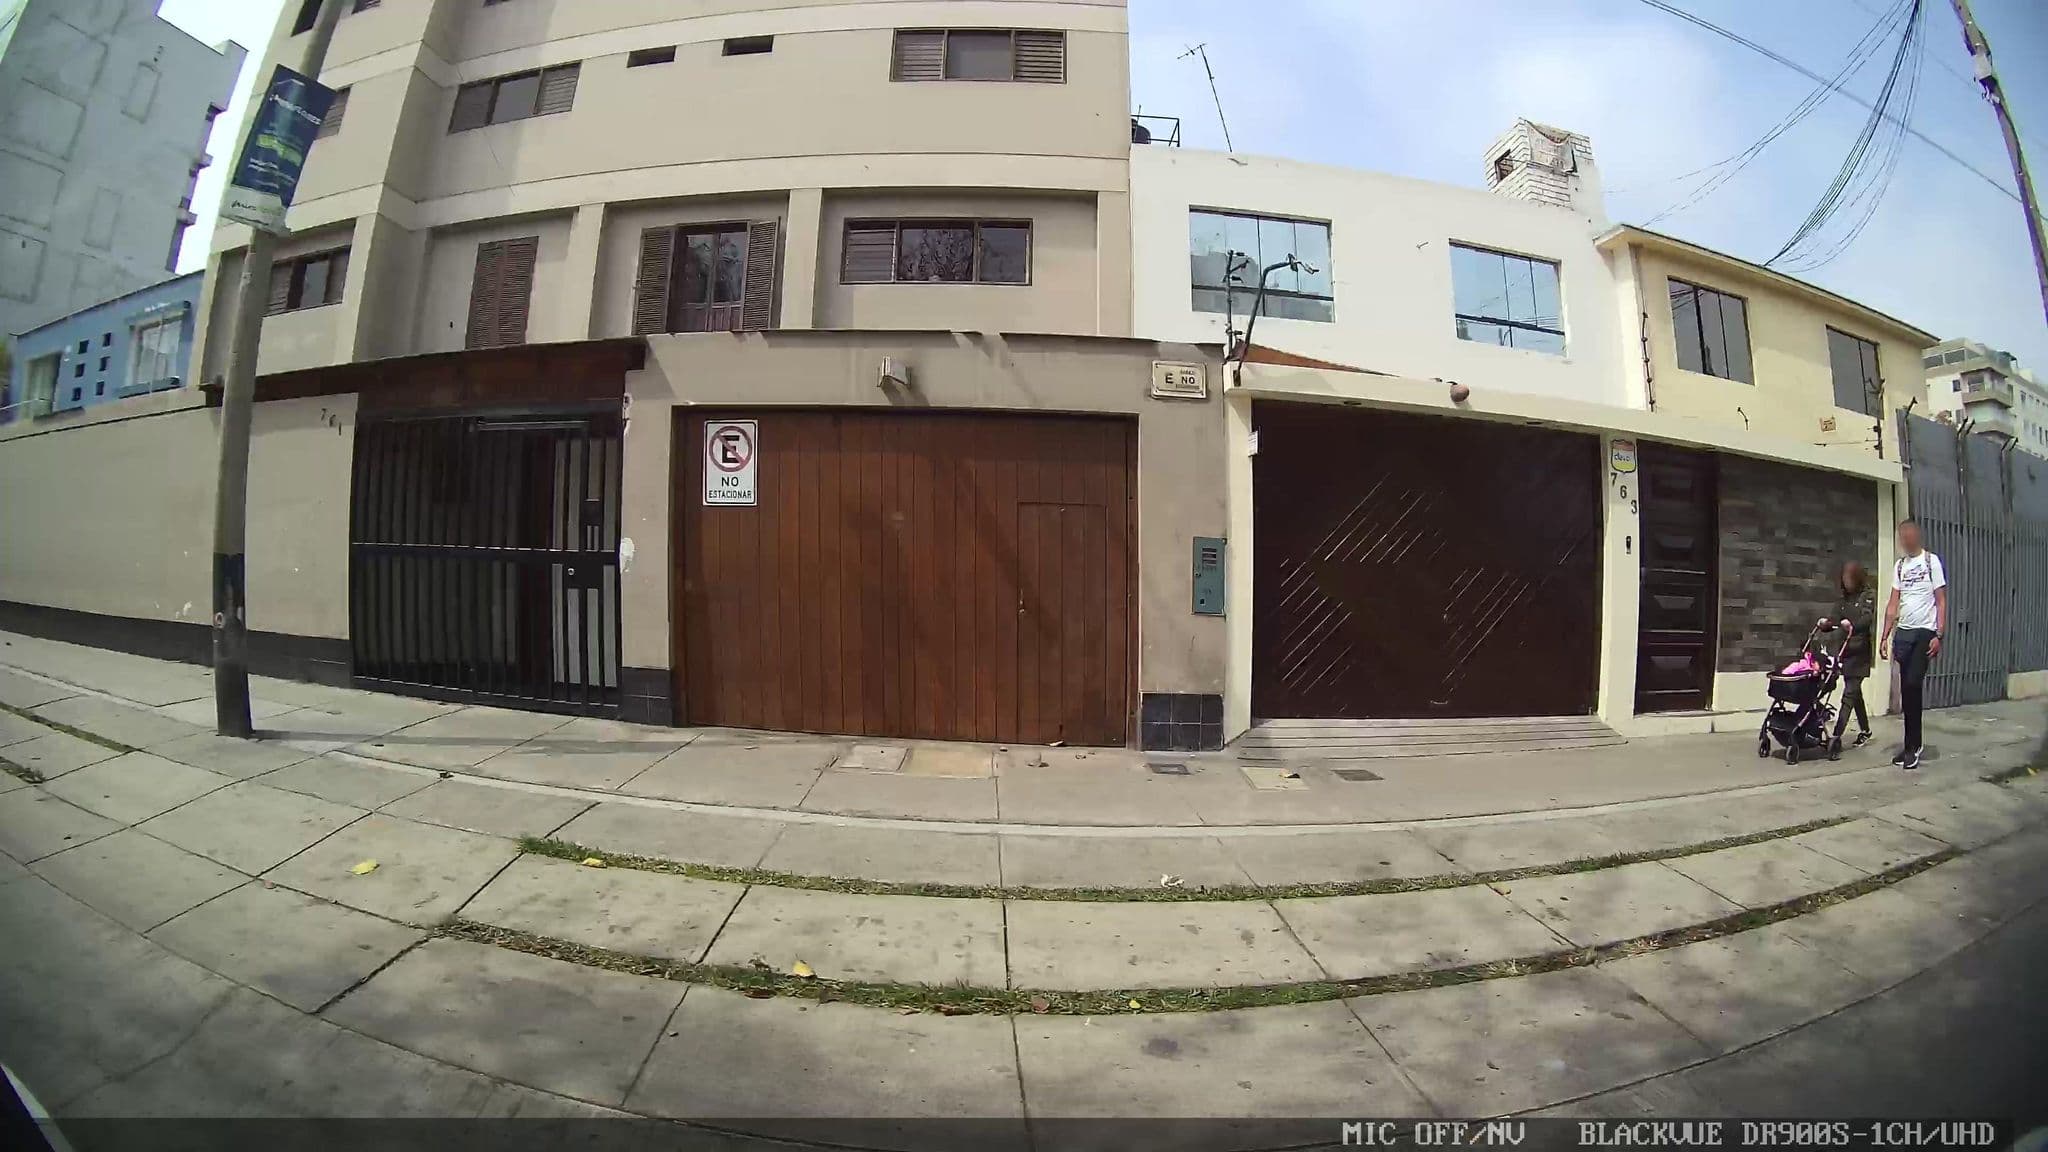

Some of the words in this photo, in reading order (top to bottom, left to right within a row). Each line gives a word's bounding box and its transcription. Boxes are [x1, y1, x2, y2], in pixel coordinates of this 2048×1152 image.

[1181, 376, 1195, 384] NO
[721, 435, 740, 463] E
[721, 476, 739, 487] NO
[708, 490, 752, 499] ESTACIONAR
